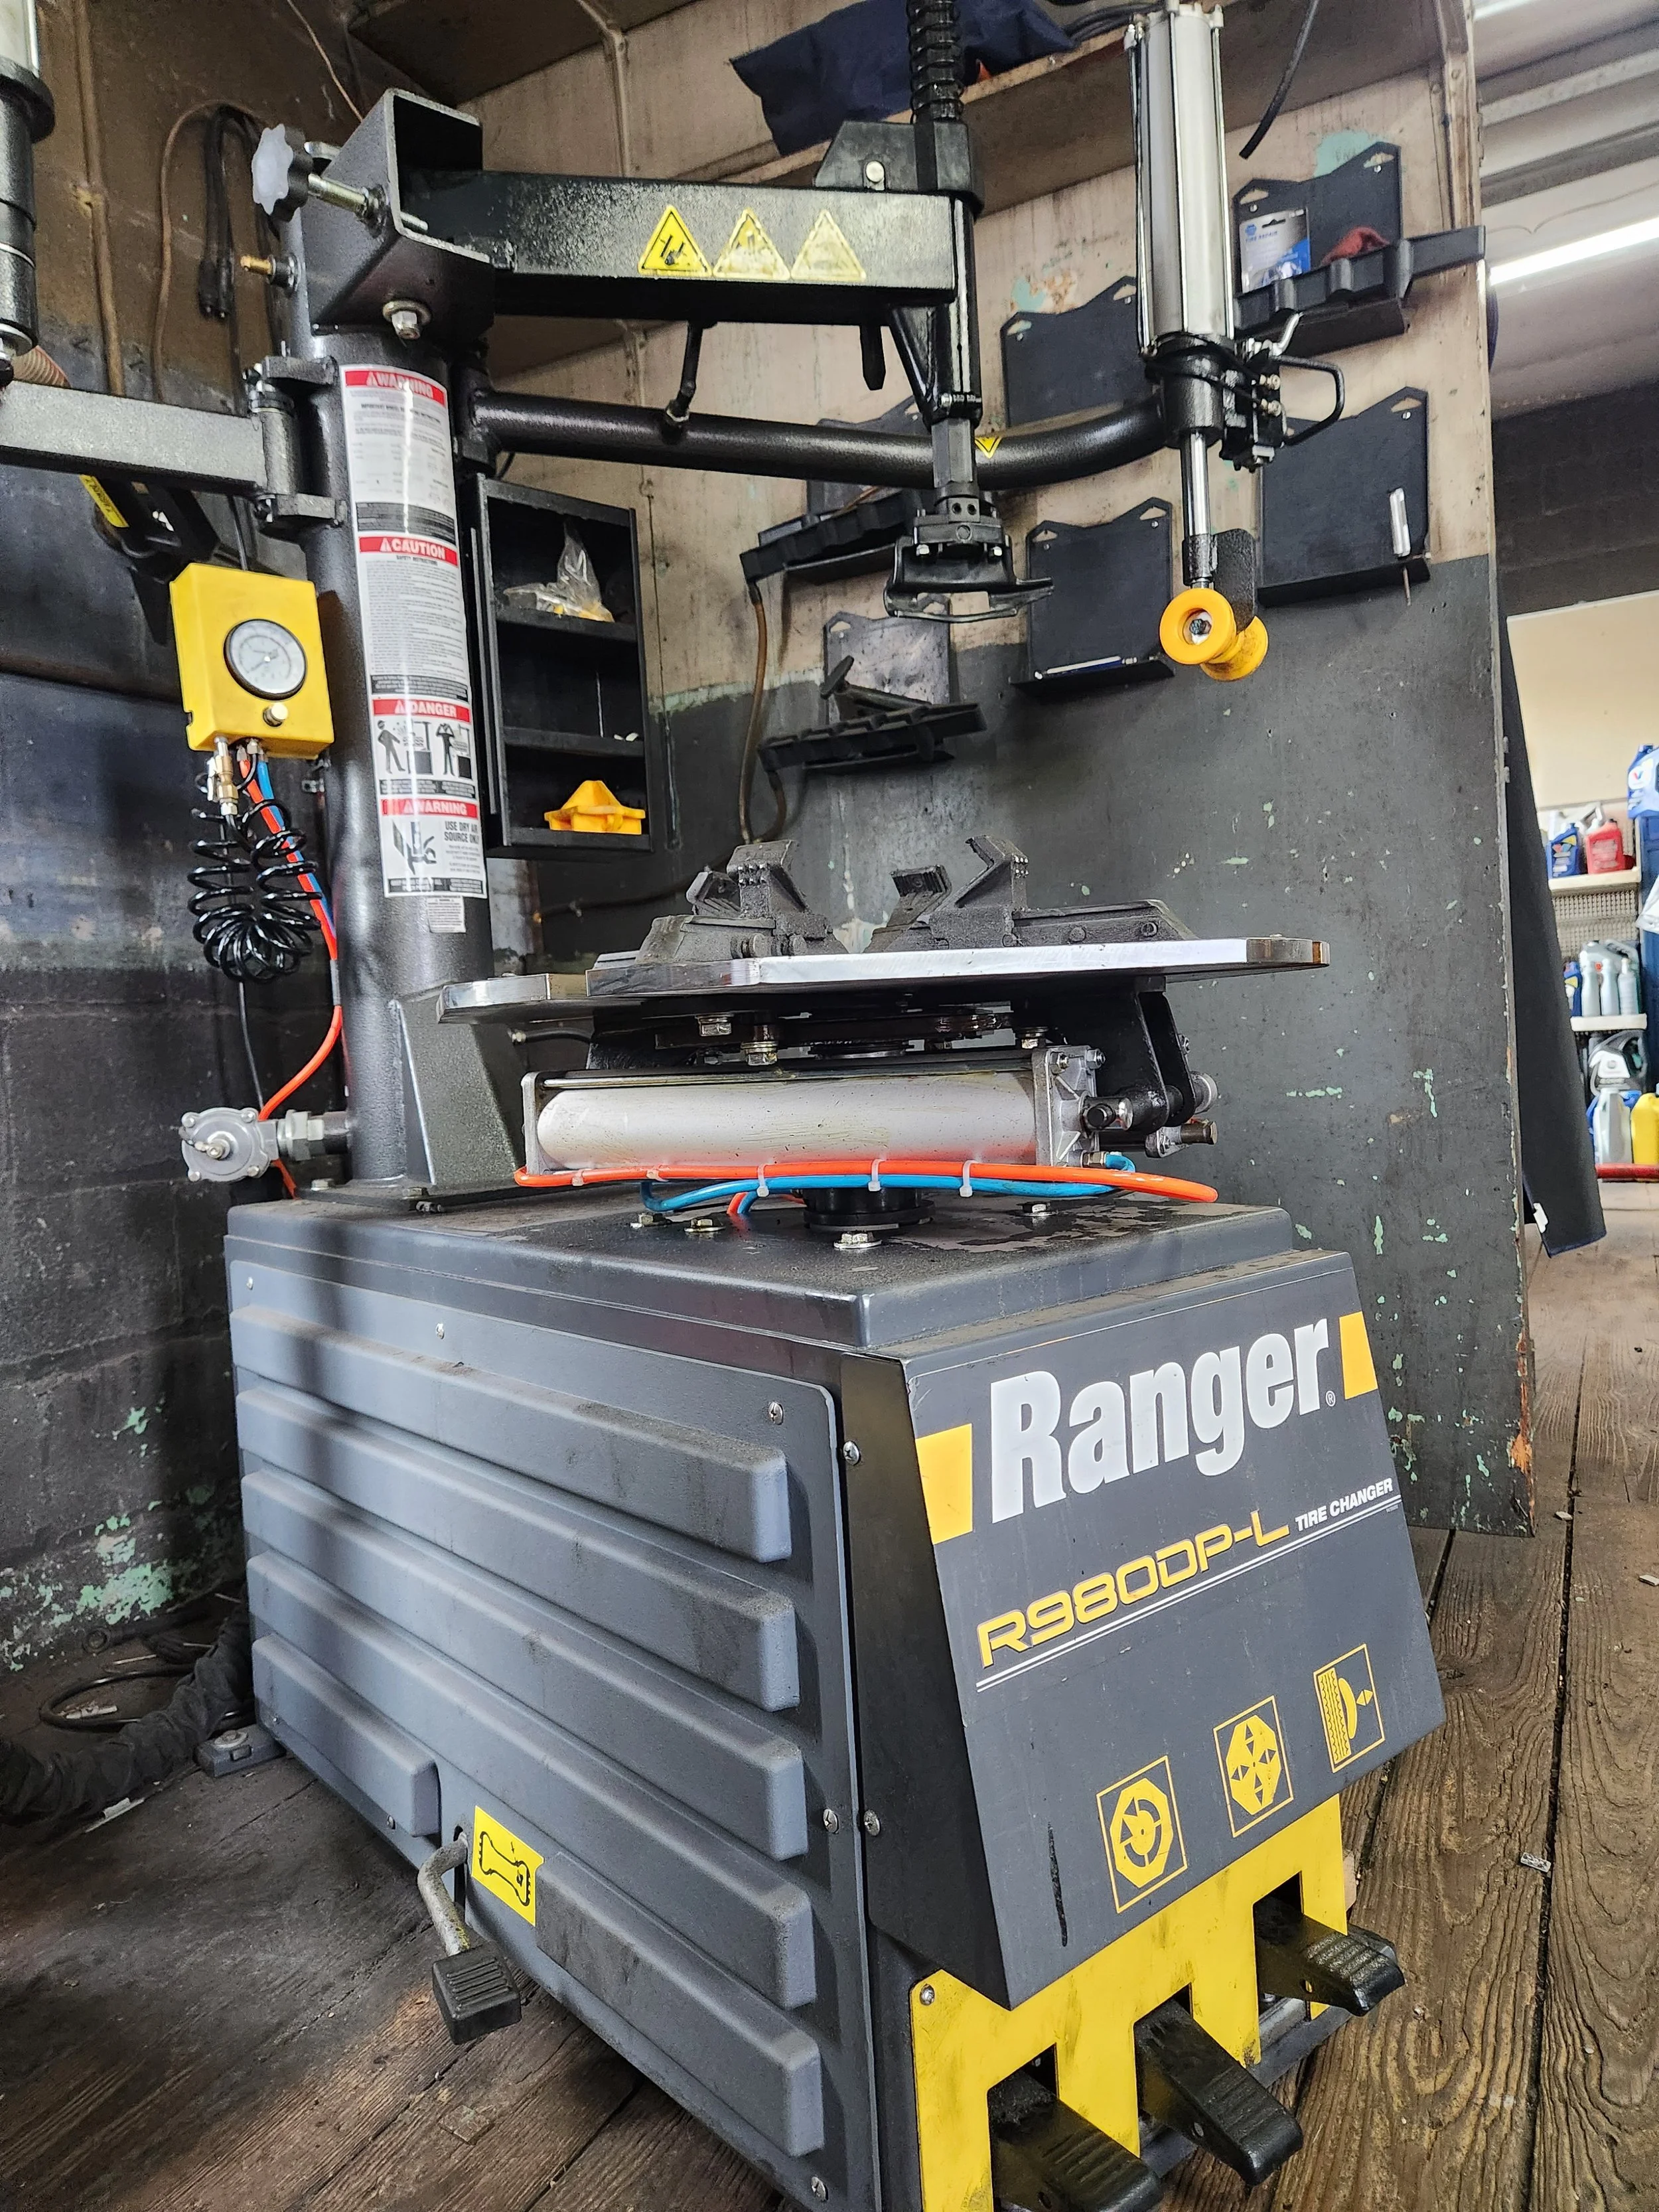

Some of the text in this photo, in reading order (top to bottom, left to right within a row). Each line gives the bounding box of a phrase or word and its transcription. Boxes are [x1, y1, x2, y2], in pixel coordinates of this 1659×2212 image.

[391, 538, 445, 560] CAUTION
[409, 700, 457, 718] DANGER
[445, 821, 457, 831] USE
[459, 822, 469, 832] DRY
[444, 832, 469, 843] SOURCE
[991, 1318, 1329, 1524] Ranger
[976, 1477, 1394, 1668] R980DP-L TIRE CHANGER
